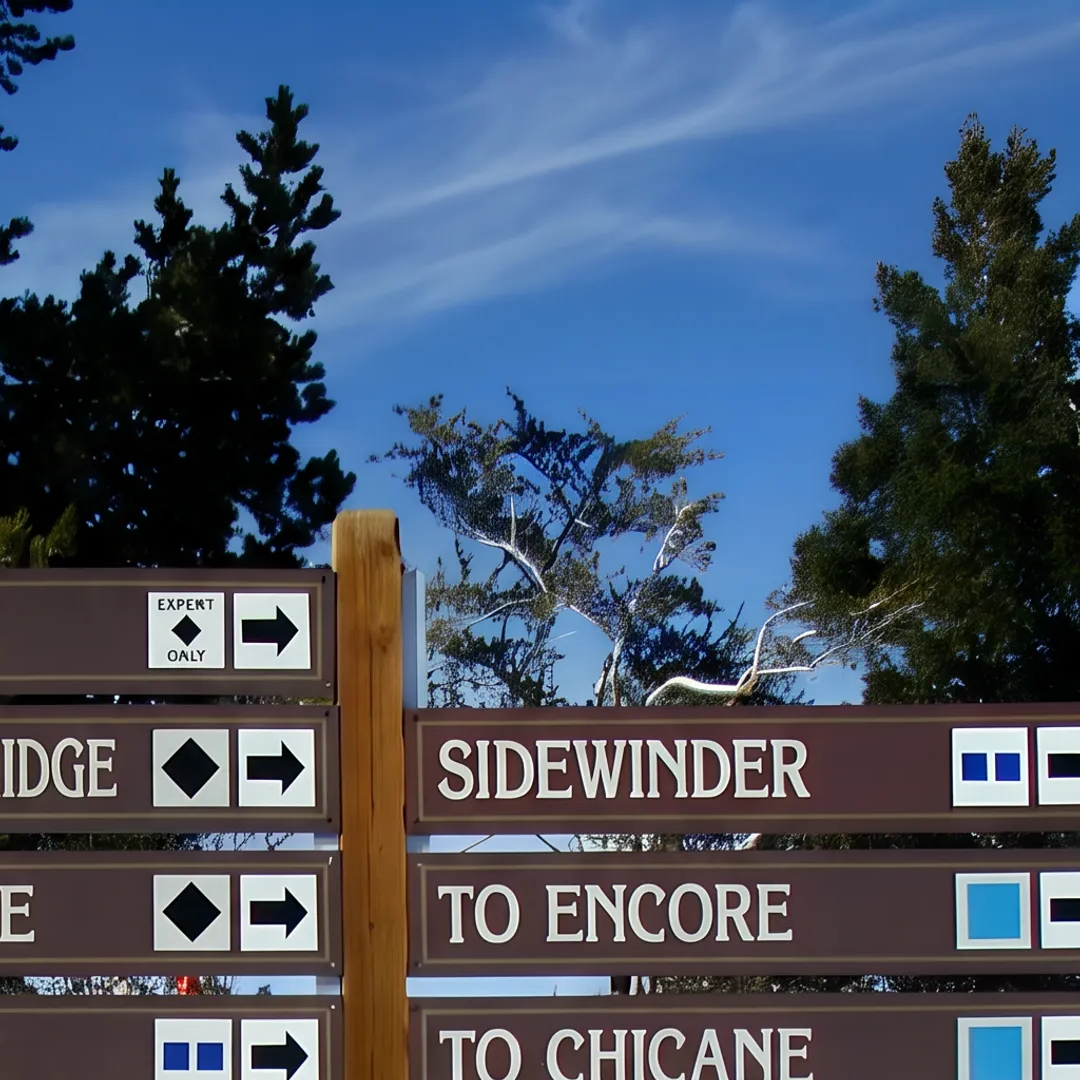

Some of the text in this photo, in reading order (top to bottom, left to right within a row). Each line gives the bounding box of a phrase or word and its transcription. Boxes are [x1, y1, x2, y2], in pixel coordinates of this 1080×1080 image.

[437, 739, 811, 801] SIDEWINDER
[437, 882, 793, 944] TO ENCORE
